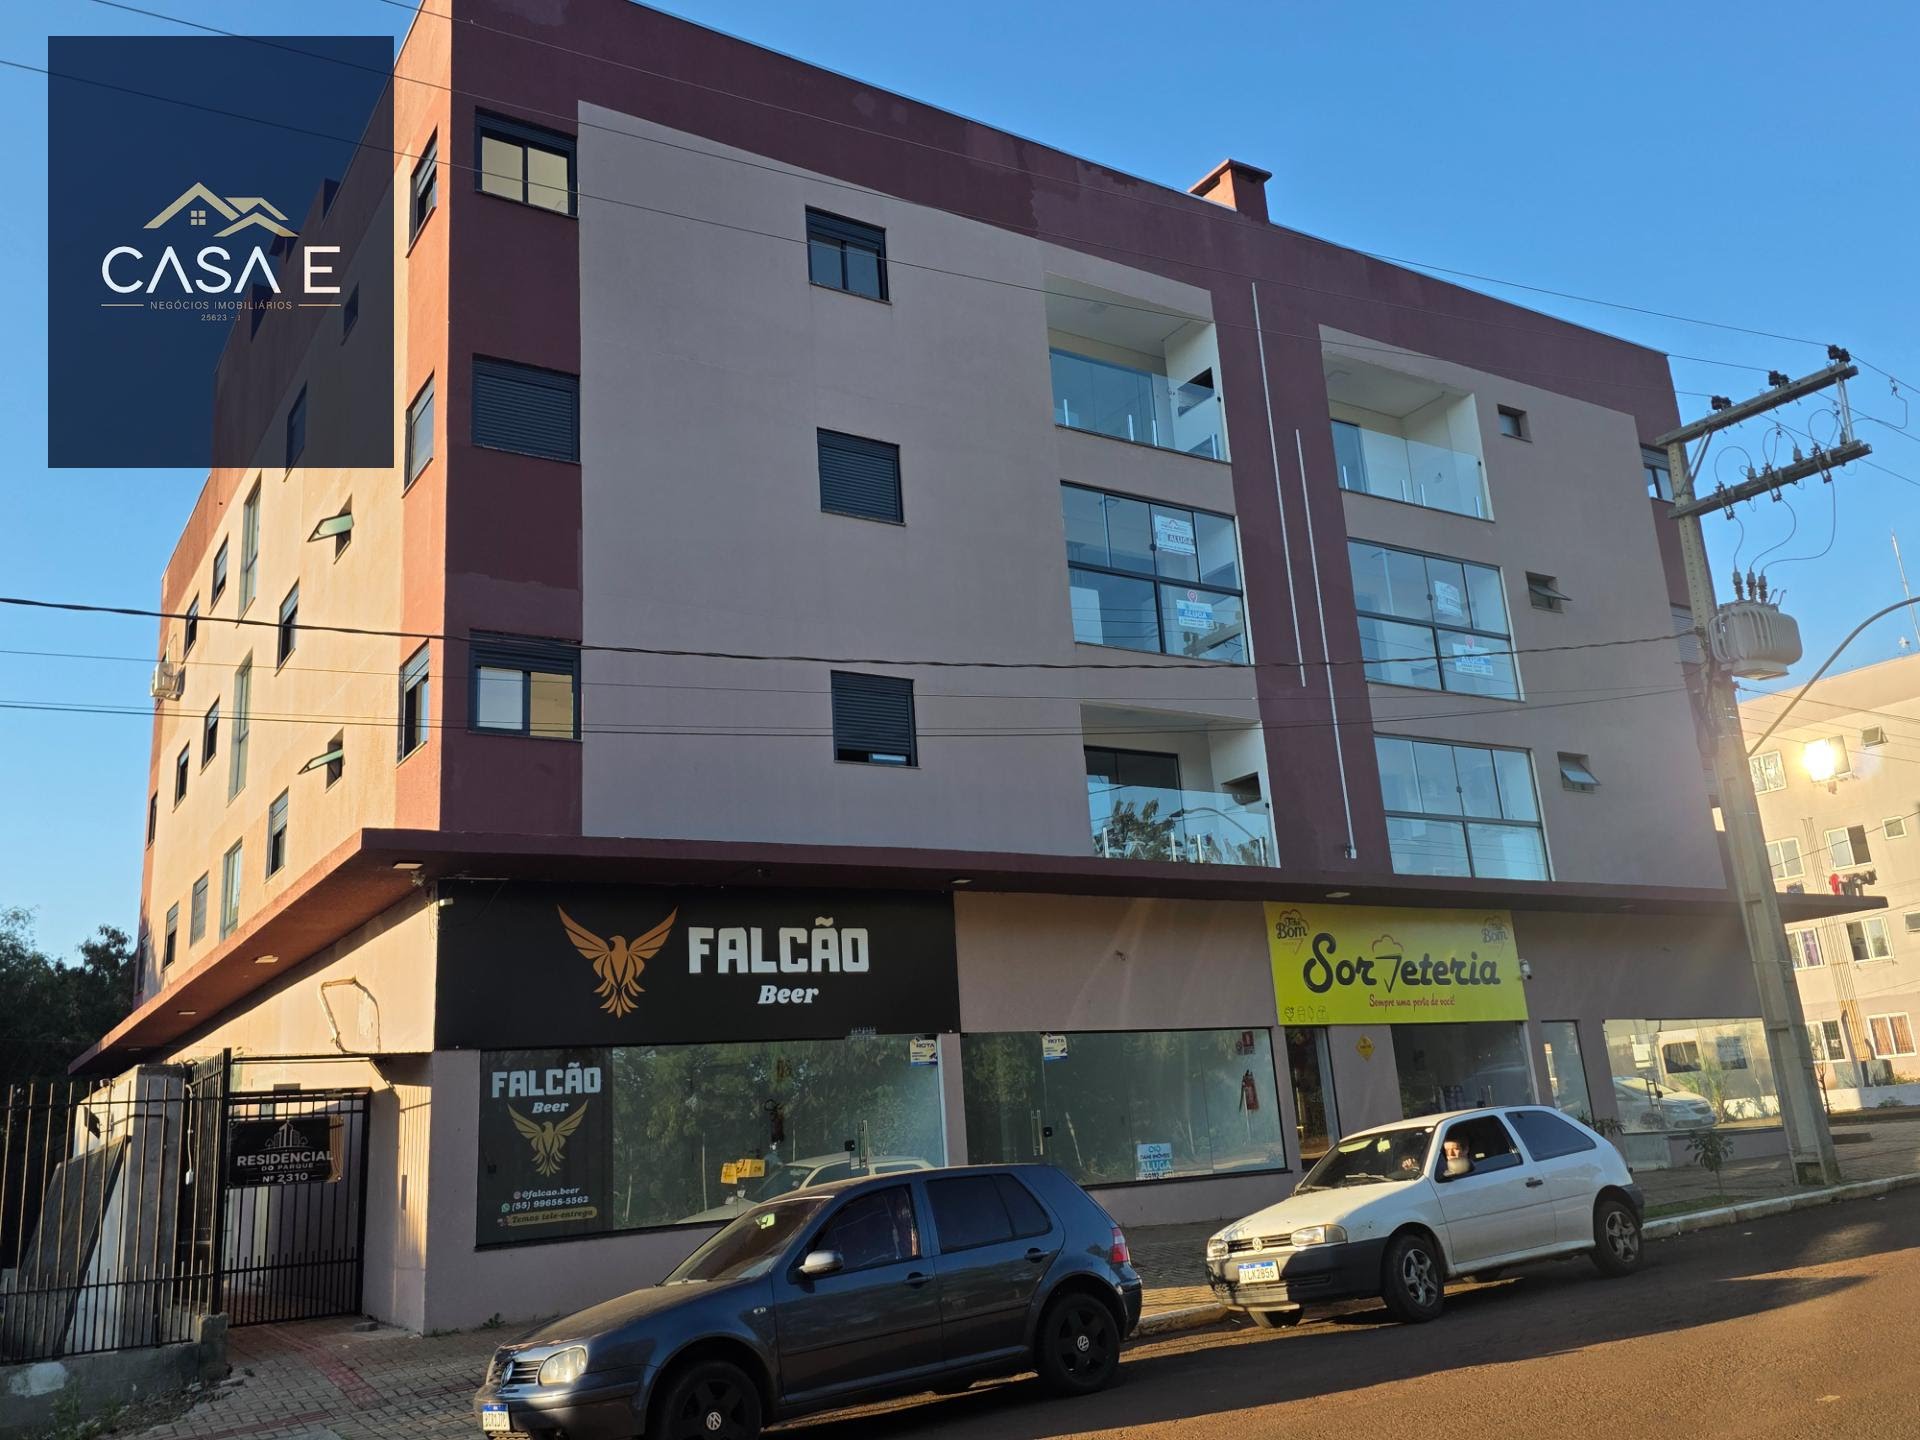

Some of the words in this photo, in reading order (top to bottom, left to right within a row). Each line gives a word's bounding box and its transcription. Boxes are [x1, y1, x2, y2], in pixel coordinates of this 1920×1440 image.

[1276, 922, 1308, 939] Bom
[1481, 928, 1508, 943] Bom
[688, 916, 869, 973] FALCÃO
[757, 984, 819, 1004] Beer
[1369, 993, 1394, 1012] Sempre
[491, 1062, 601, 1098] FALCÃO
[532, 1102, 569, 1114] Beer
[237, 1150, 333, 1166] RESIDENCIAL
[1140, 1160, 1172, 1171] ALUGA
[277, 1172, 308, 1183] 2310
[512, 1213, 539, 1223] Temos
